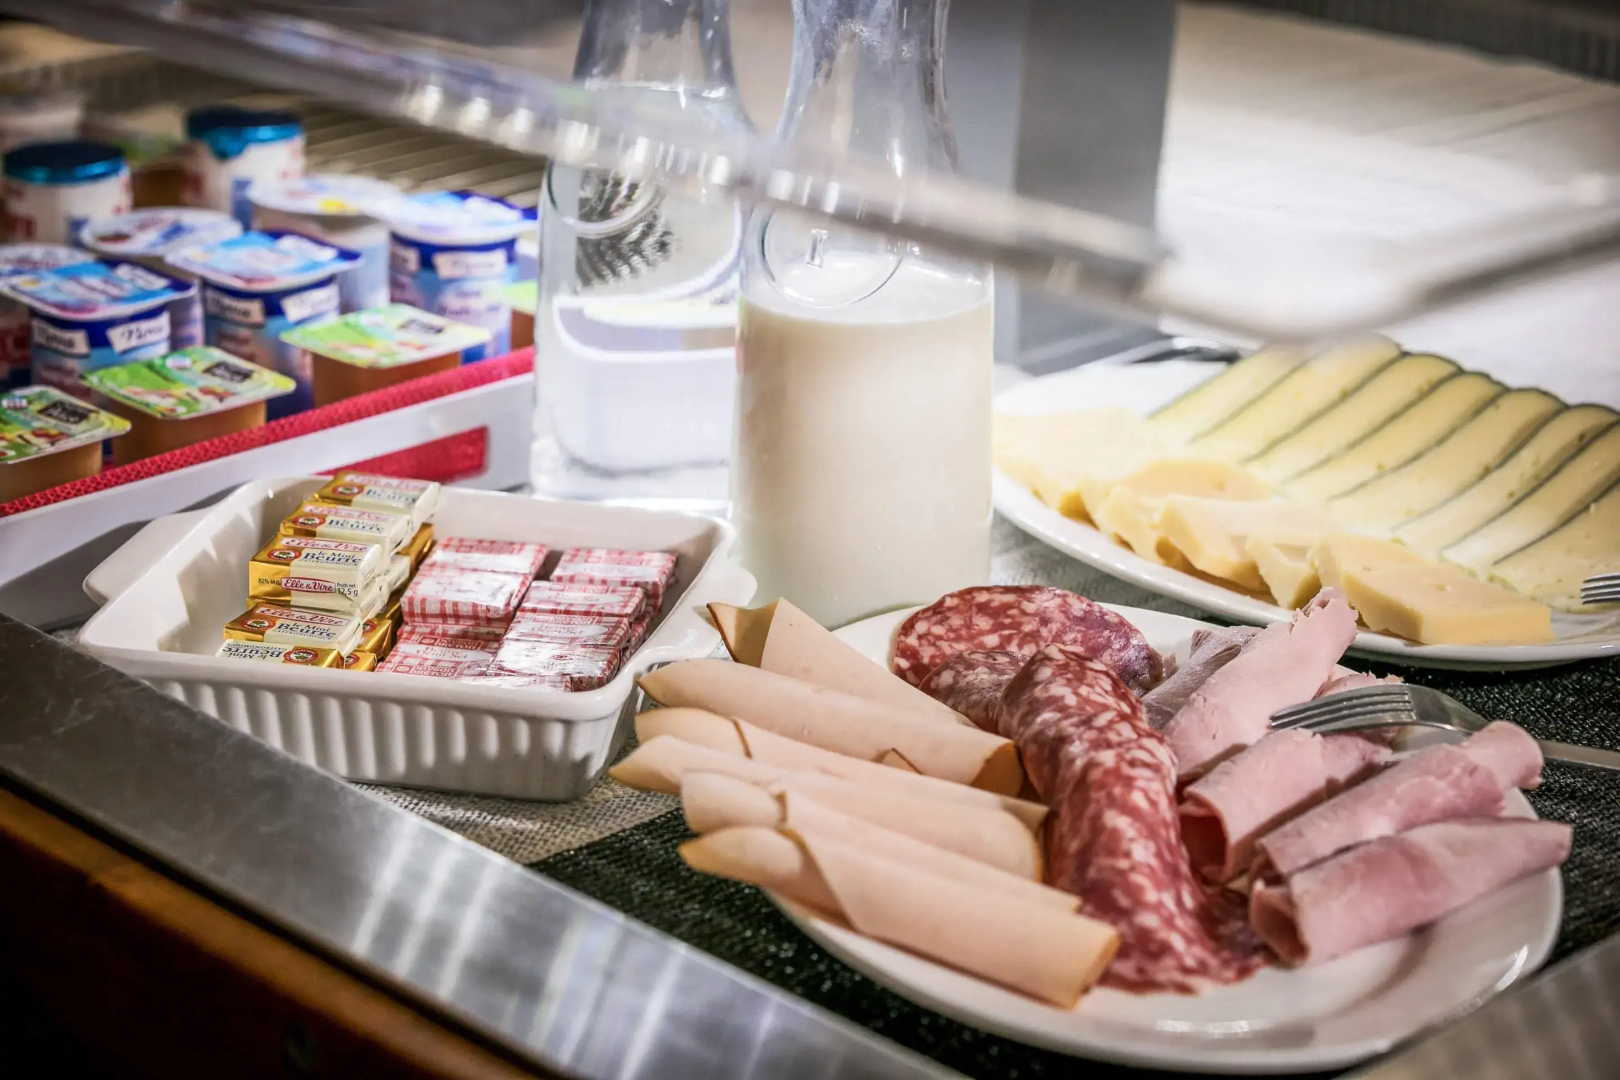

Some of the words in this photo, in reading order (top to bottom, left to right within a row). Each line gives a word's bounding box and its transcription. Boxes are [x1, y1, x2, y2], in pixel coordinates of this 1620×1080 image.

[285, 539, 320, 548] Elle
[334, 542, 368, 552] Vire
[303, 552, 361, 563] Beurre
[284, 579, 305, 590] Elle
[312, 581, 334, 592] Vire
[337, 587, 352, 597] 12,5
[260, 608, 295, 619] Elle
[309, 615, 343, 625] Vire
[277, 623, 336, 638] Beurre
[305, 624, 331, 632] Mini
[222, 646, 282, 658] Beurre
